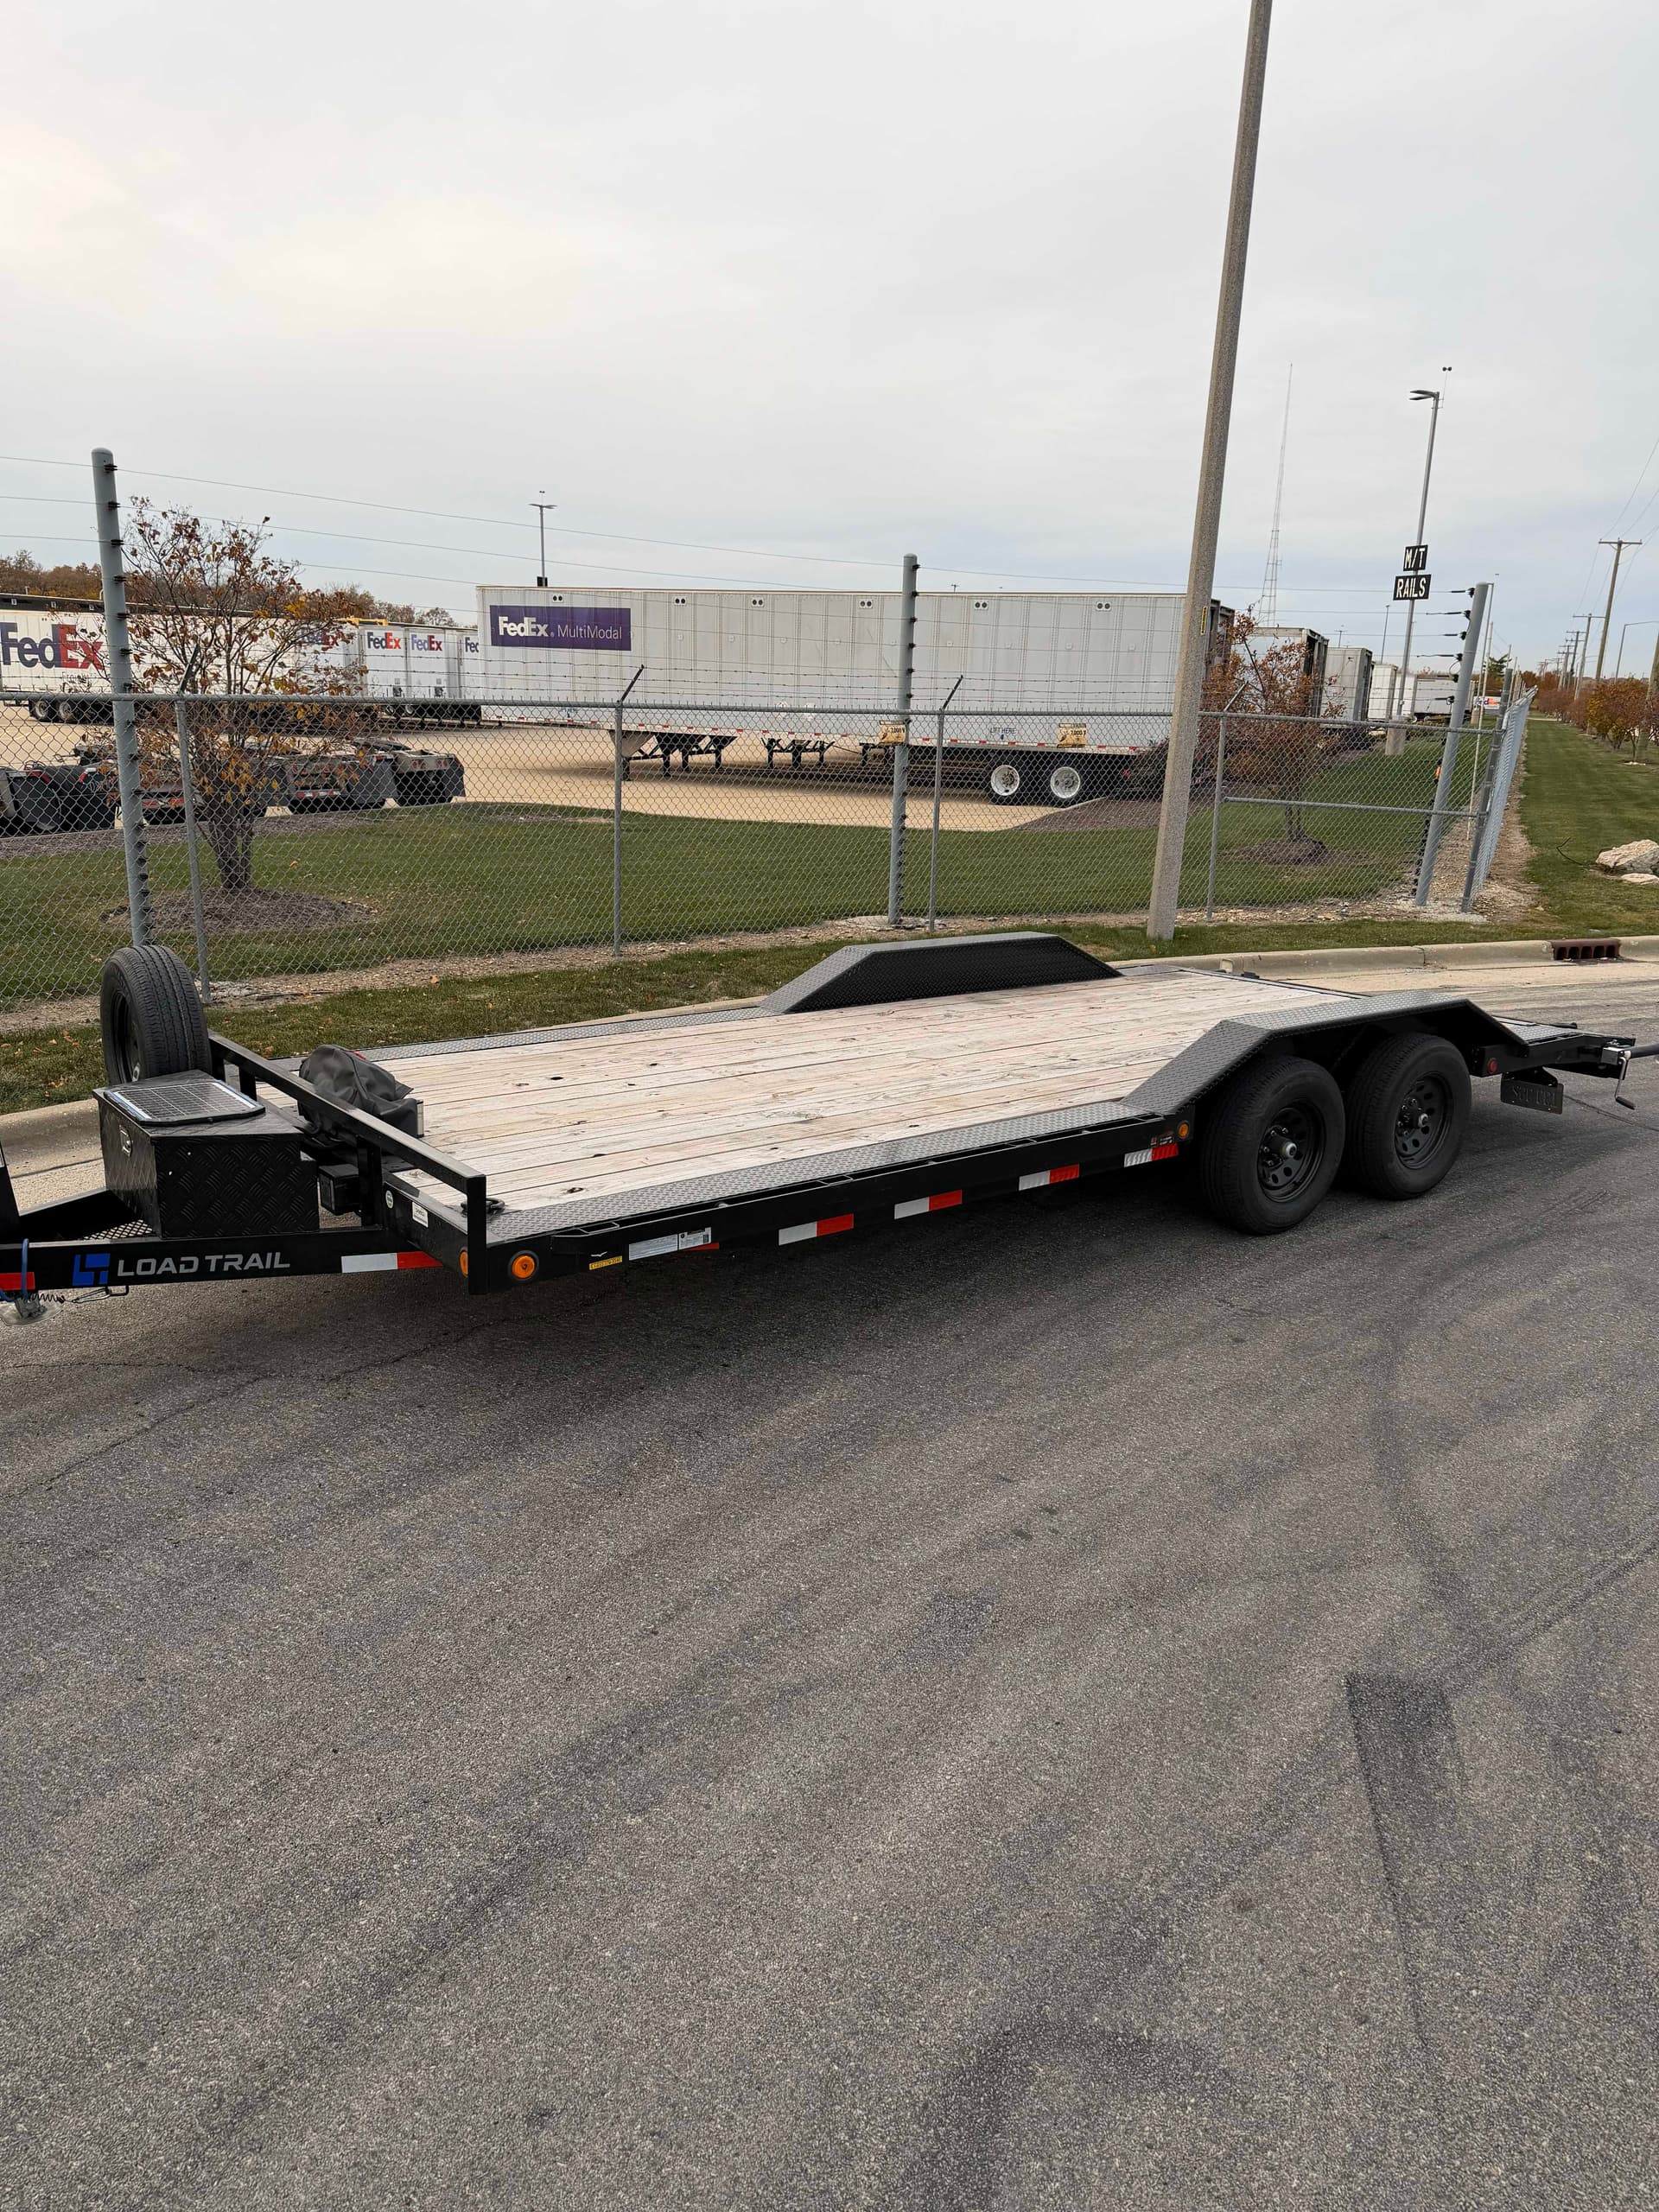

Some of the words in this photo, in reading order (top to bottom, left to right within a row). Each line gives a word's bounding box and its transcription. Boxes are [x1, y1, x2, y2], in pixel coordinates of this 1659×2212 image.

[1404, 547, 1426, 569] M/T
[1395, 577, 1426, 598] RAILS
[499, 616, 550, 638] FedEx
[557, 624, 622, 639] MultiModal
[0, 621, 105, 671] FedEx
[367, 632, 402, 650] FedEx
[411, 633, 443, 652] FedEx
[118, 1256, 199, 1277] LOAD
[205, 1252, 291, 1272] TRAIL
